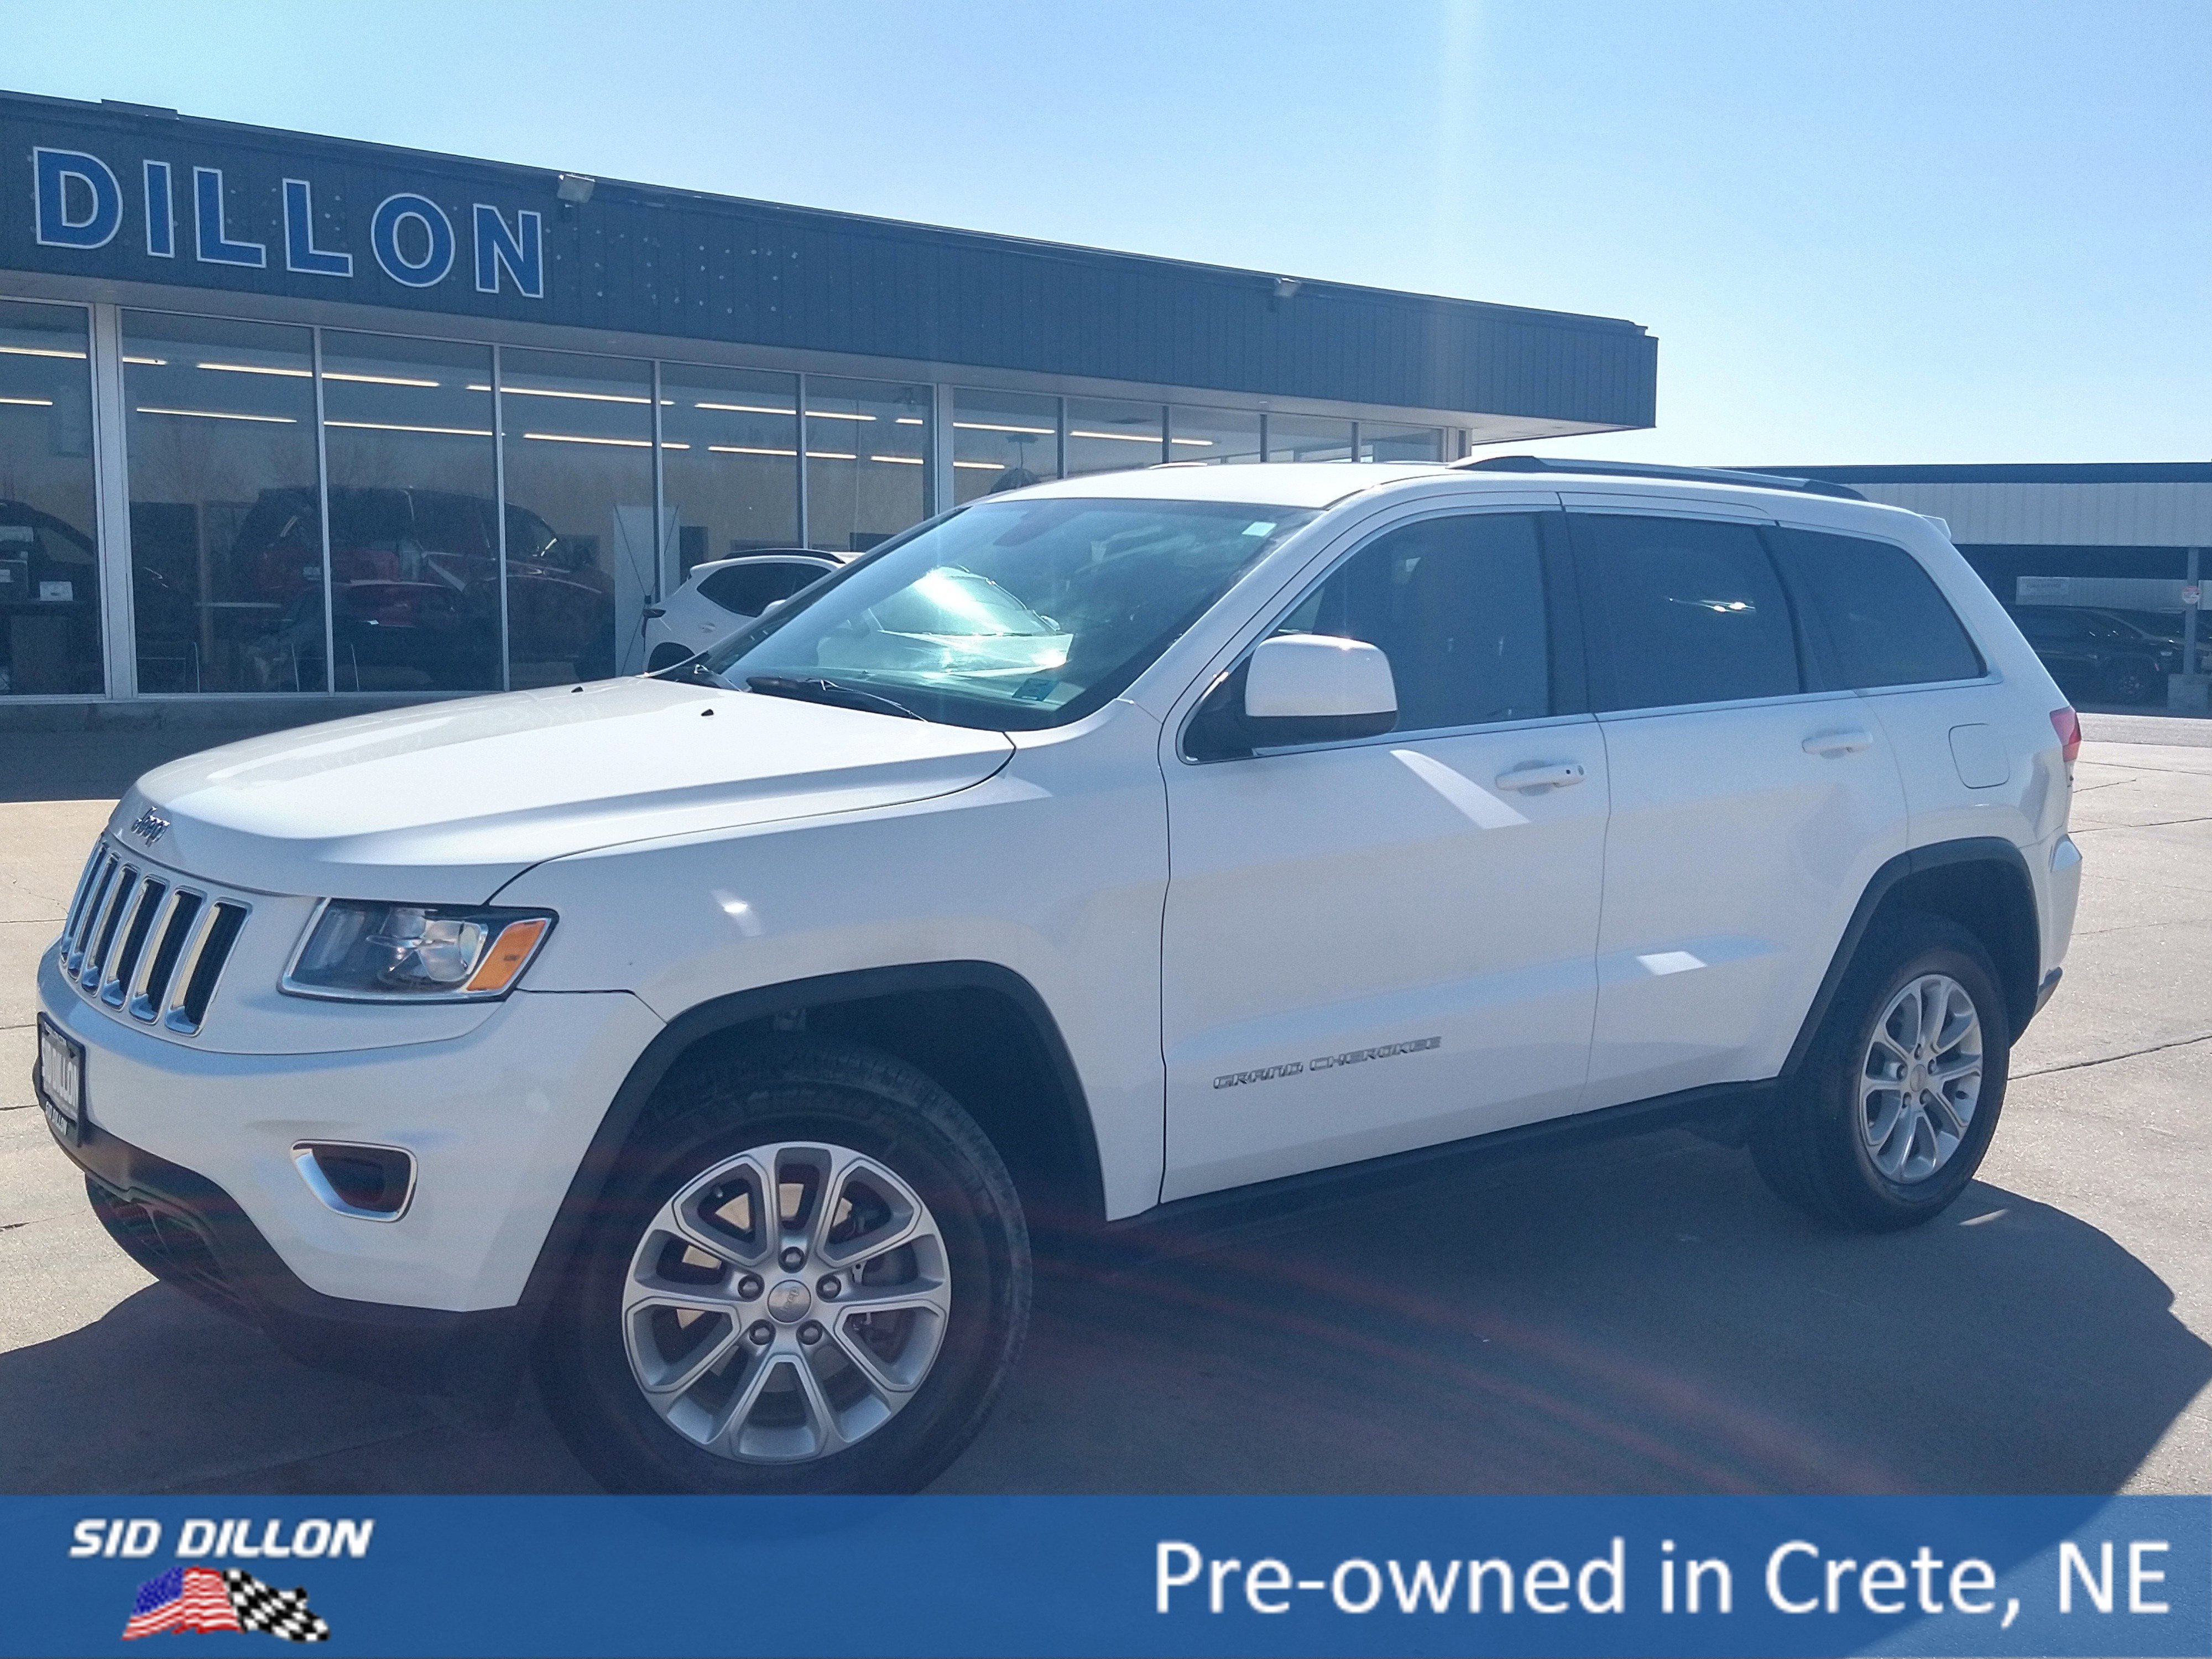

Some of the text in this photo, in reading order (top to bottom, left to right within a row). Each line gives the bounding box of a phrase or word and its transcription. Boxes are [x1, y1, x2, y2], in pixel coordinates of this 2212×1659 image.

[32, 145, 544, 299] DILLON
[131, 806, 170, 848] Jeep
[1213, 1035, 1442, 1089] GRAND CHEROKEE
